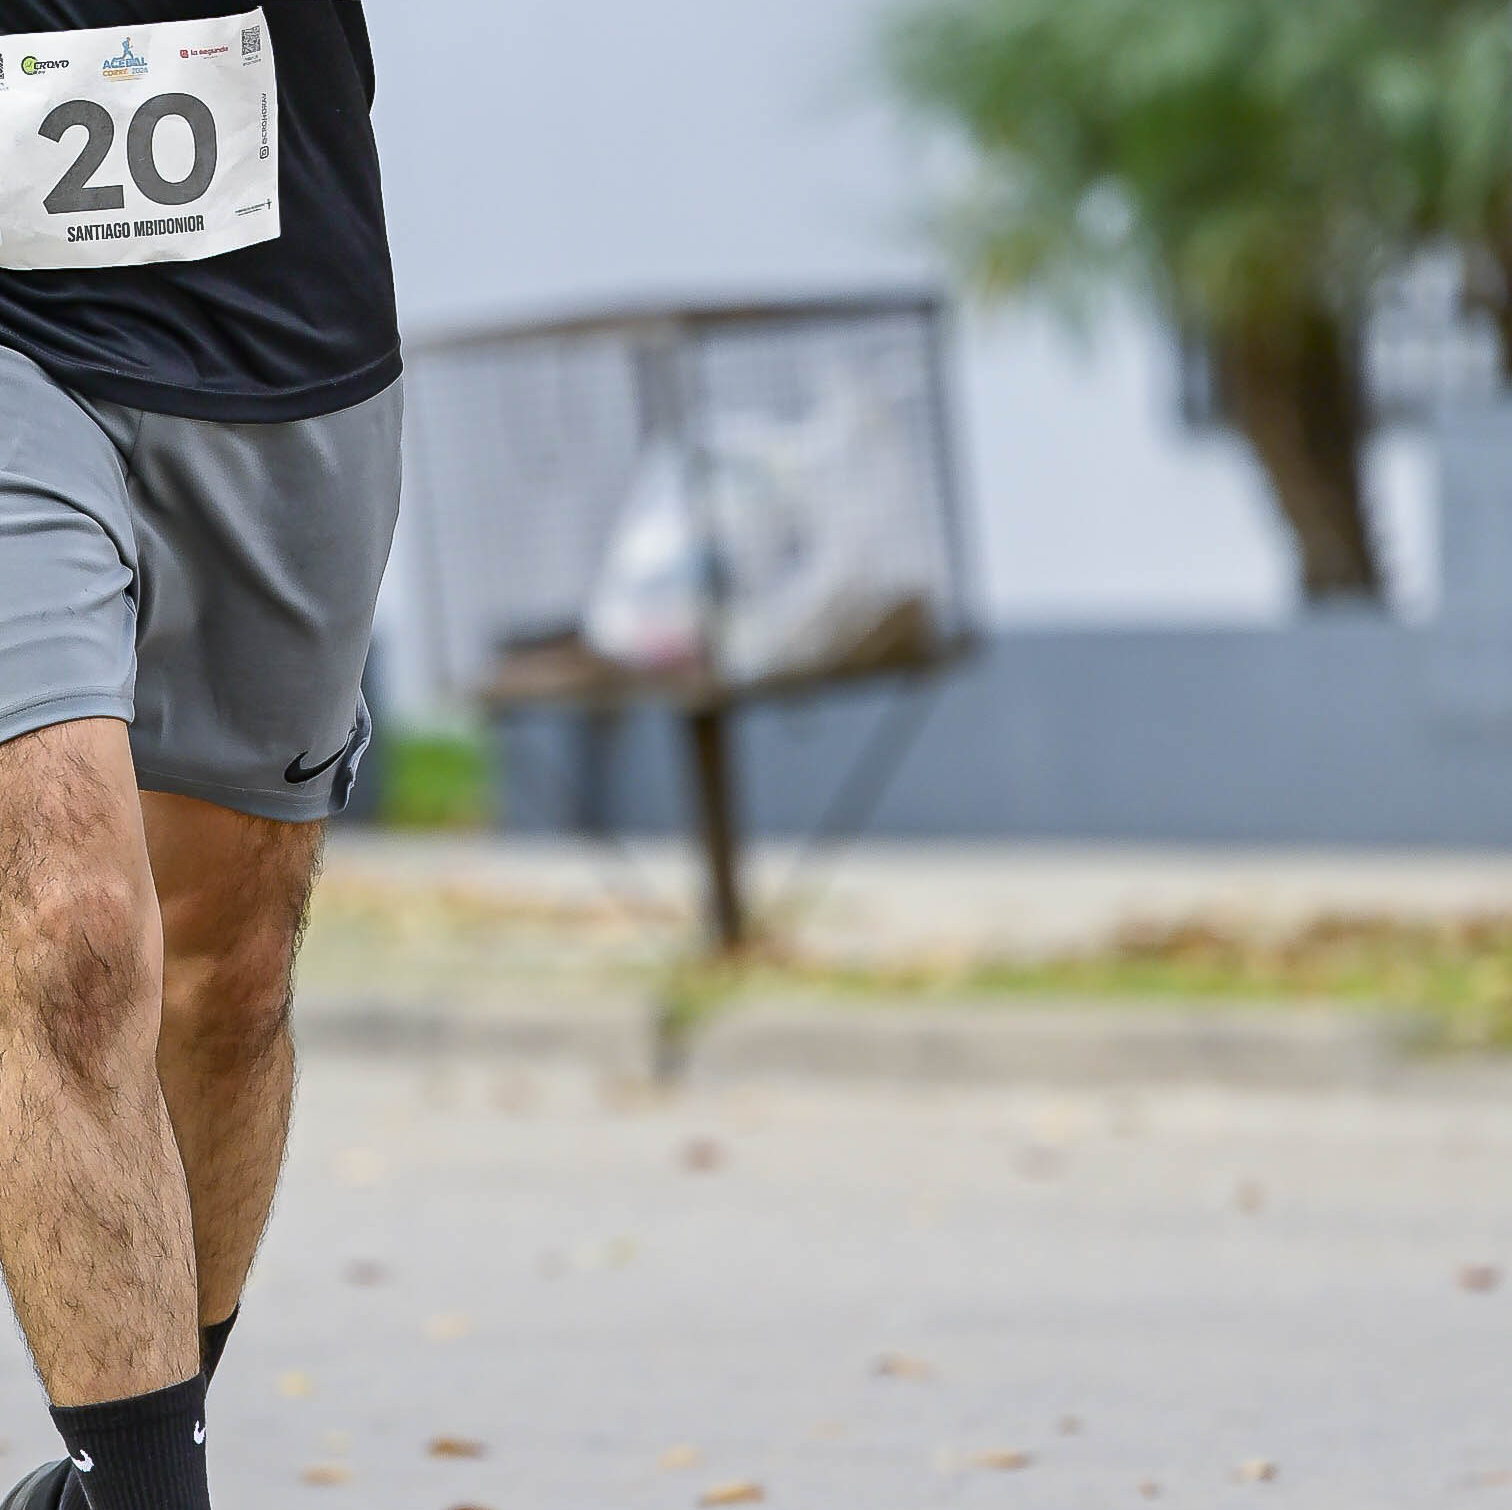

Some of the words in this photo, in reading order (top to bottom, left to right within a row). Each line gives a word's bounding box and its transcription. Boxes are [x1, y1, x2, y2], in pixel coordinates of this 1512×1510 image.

[37, 93, 218, 215] 20
[67, 222, 131, 243] SANTIAGO
[133, 214, 205, 238] MBIDONIOR
